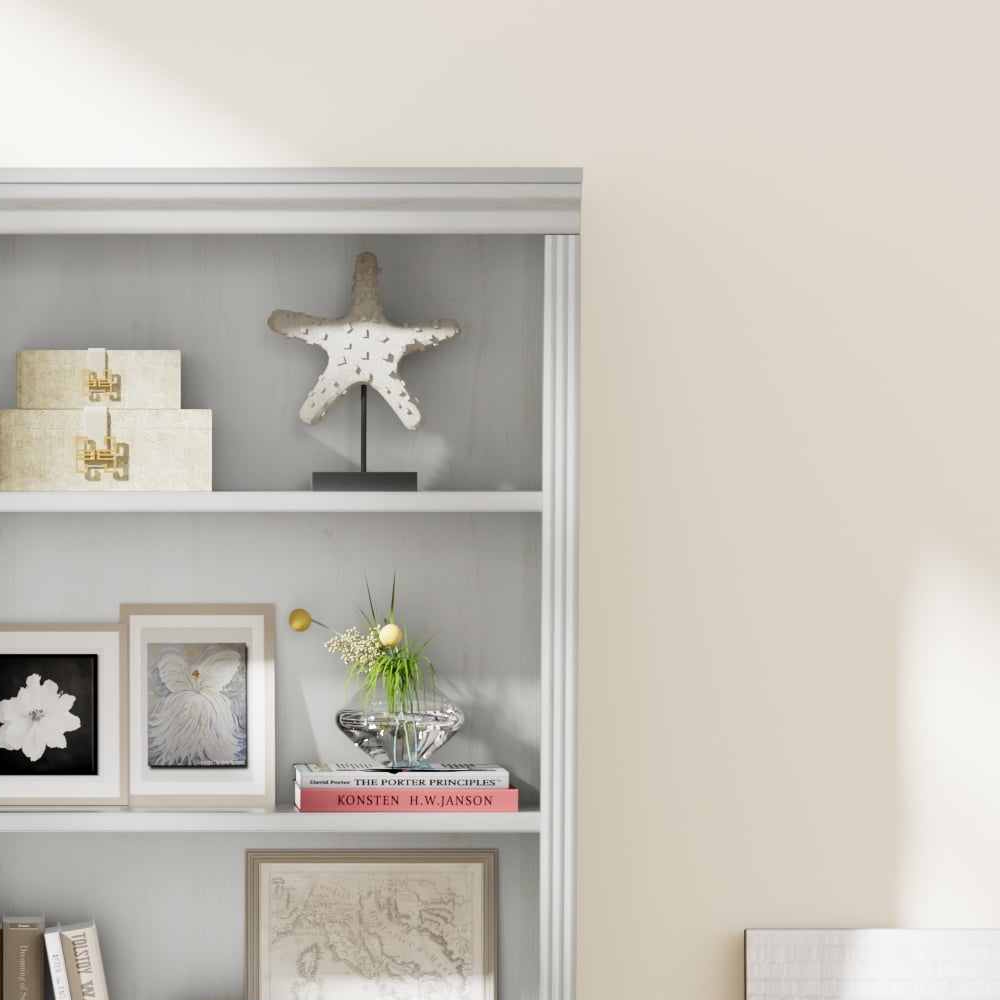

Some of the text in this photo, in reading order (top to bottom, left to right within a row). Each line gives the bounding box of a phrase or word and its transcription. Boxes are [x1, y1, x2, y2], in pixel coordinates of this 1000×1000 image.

[337, 794, 493, 807] KONSTEN H.W.JANSON
[70, 932, 92, 974] TOLSTOY
